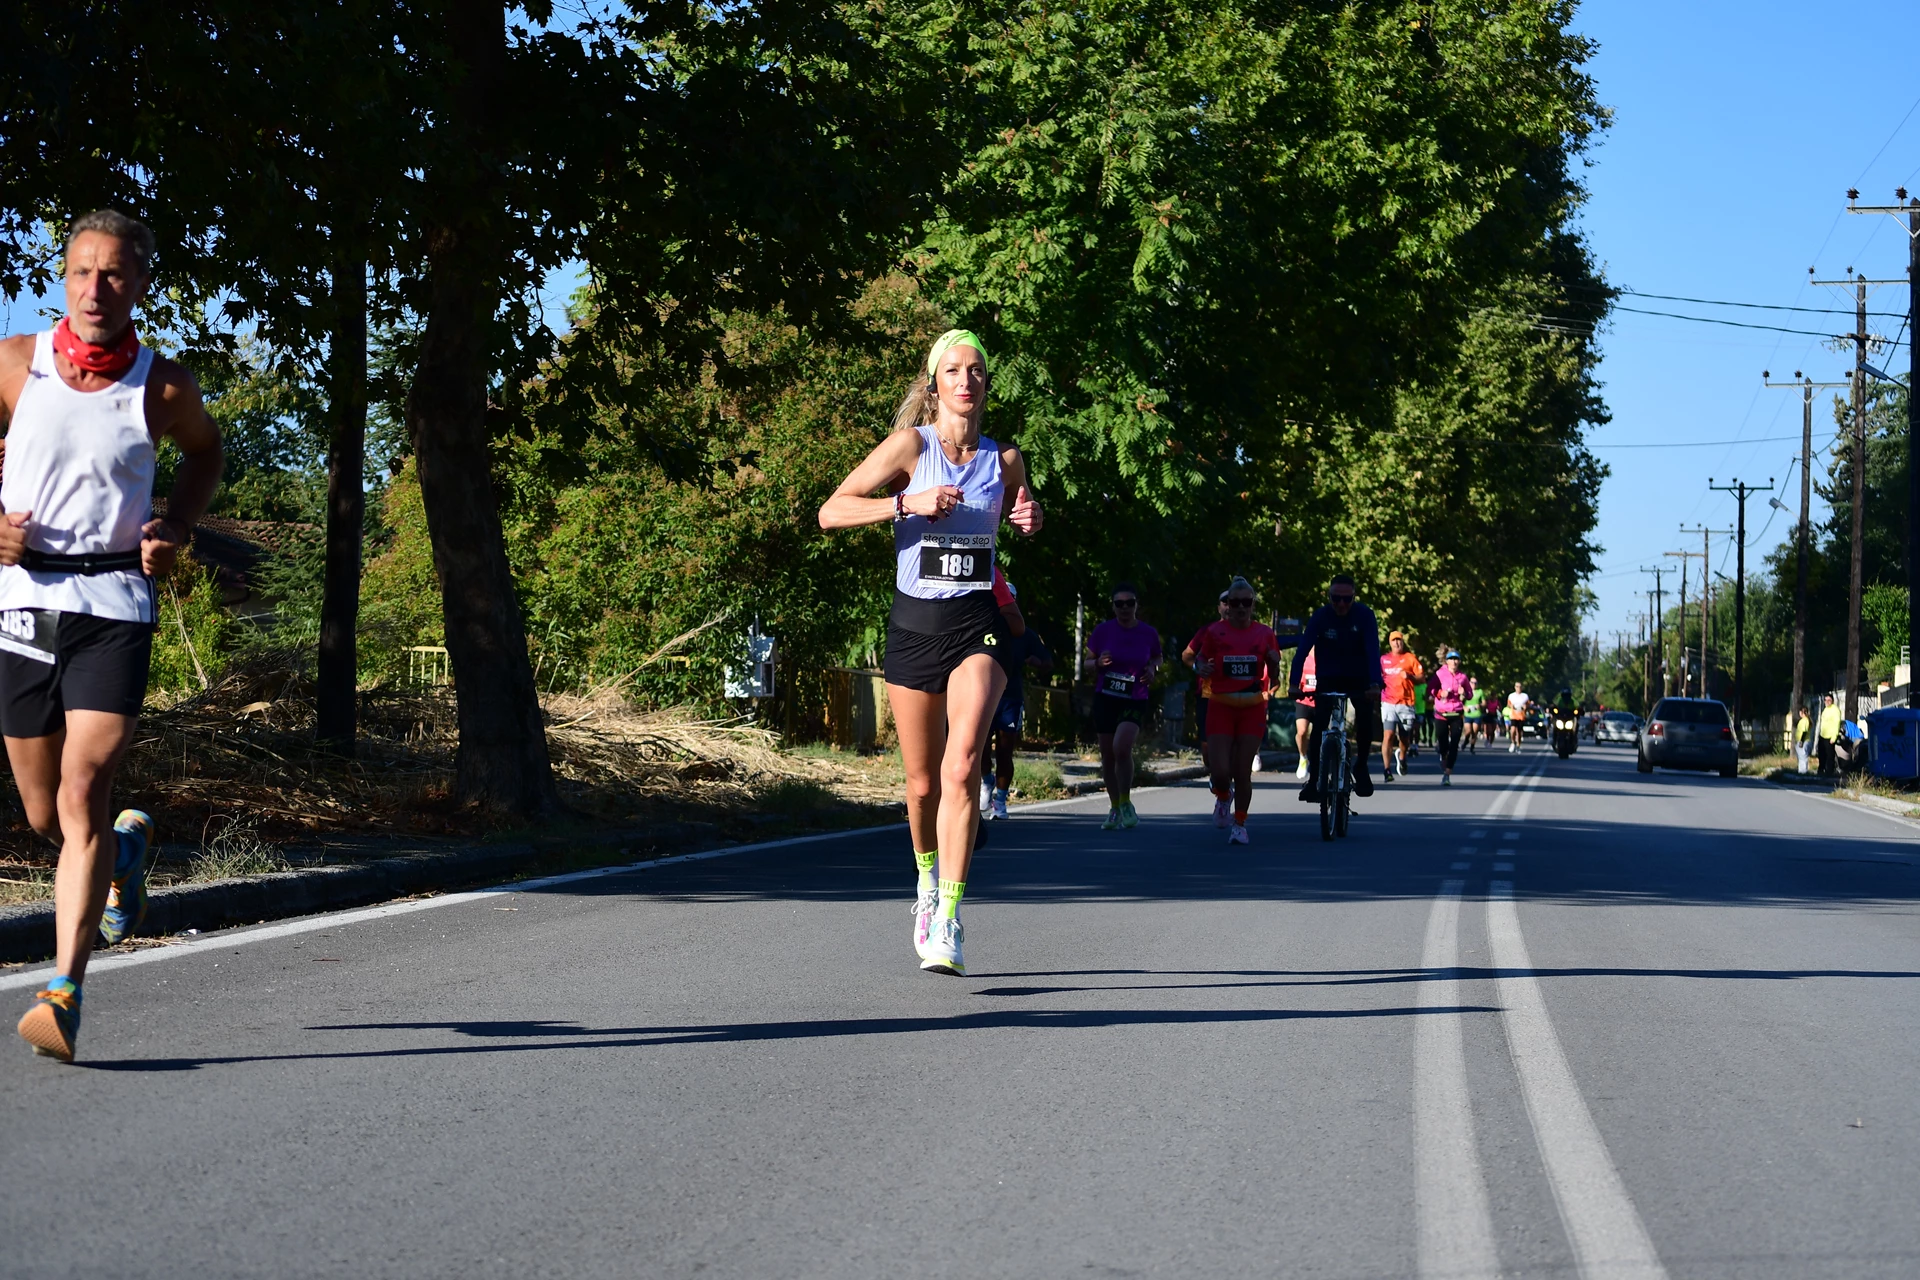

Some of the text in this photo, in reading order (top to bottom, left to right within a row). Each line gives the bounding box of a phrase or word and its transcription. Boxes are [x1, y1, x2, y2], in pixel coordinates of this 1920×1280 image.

[923, 534, 990, 547] step step step
[939, 553, 974, 577] 189
[1231, 664, 1250, 674] 334
[1110, 680, 1126, 691] 284
